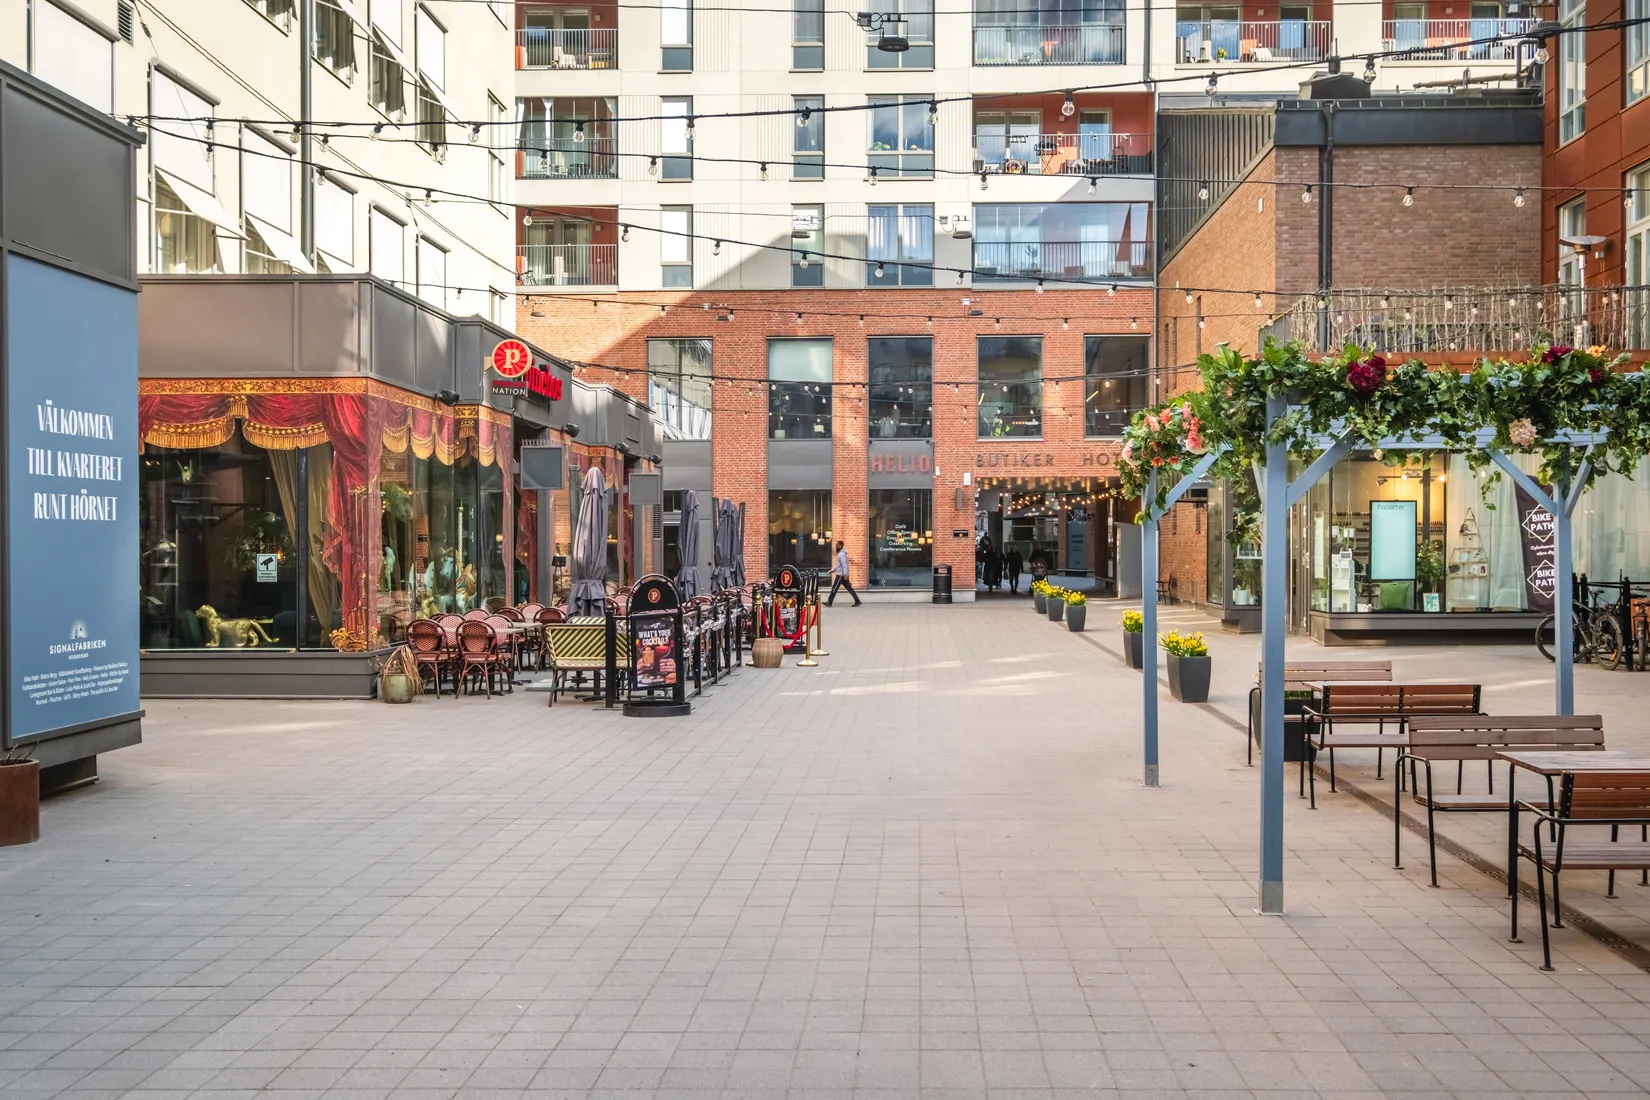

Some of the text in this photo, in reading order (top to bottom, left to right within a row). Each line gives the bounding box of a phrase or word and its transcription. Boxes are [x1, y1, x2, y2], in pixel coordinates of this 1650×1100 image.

[492, 387, 526, 395] NATION
[37, 399, 114, 440] VÄLKOMMEN
[26, 447, 123, 481] TILL KVARTERET
[870, 454, 931, 473] HELIO
[975, 453, 1054, 467] BUTIKER
[34, 489, 118, 521] RUNT HÖRNET
[1531, 512, 1552, 522] BIKE
[1530, 521, 1554, 532] PATH
[1537, 569, 1554, 578] BIKE
[638, 628, 672, 639] WHAT'S YOUR
[49, 639, 107, 654] SIGNALFABRIKEN
